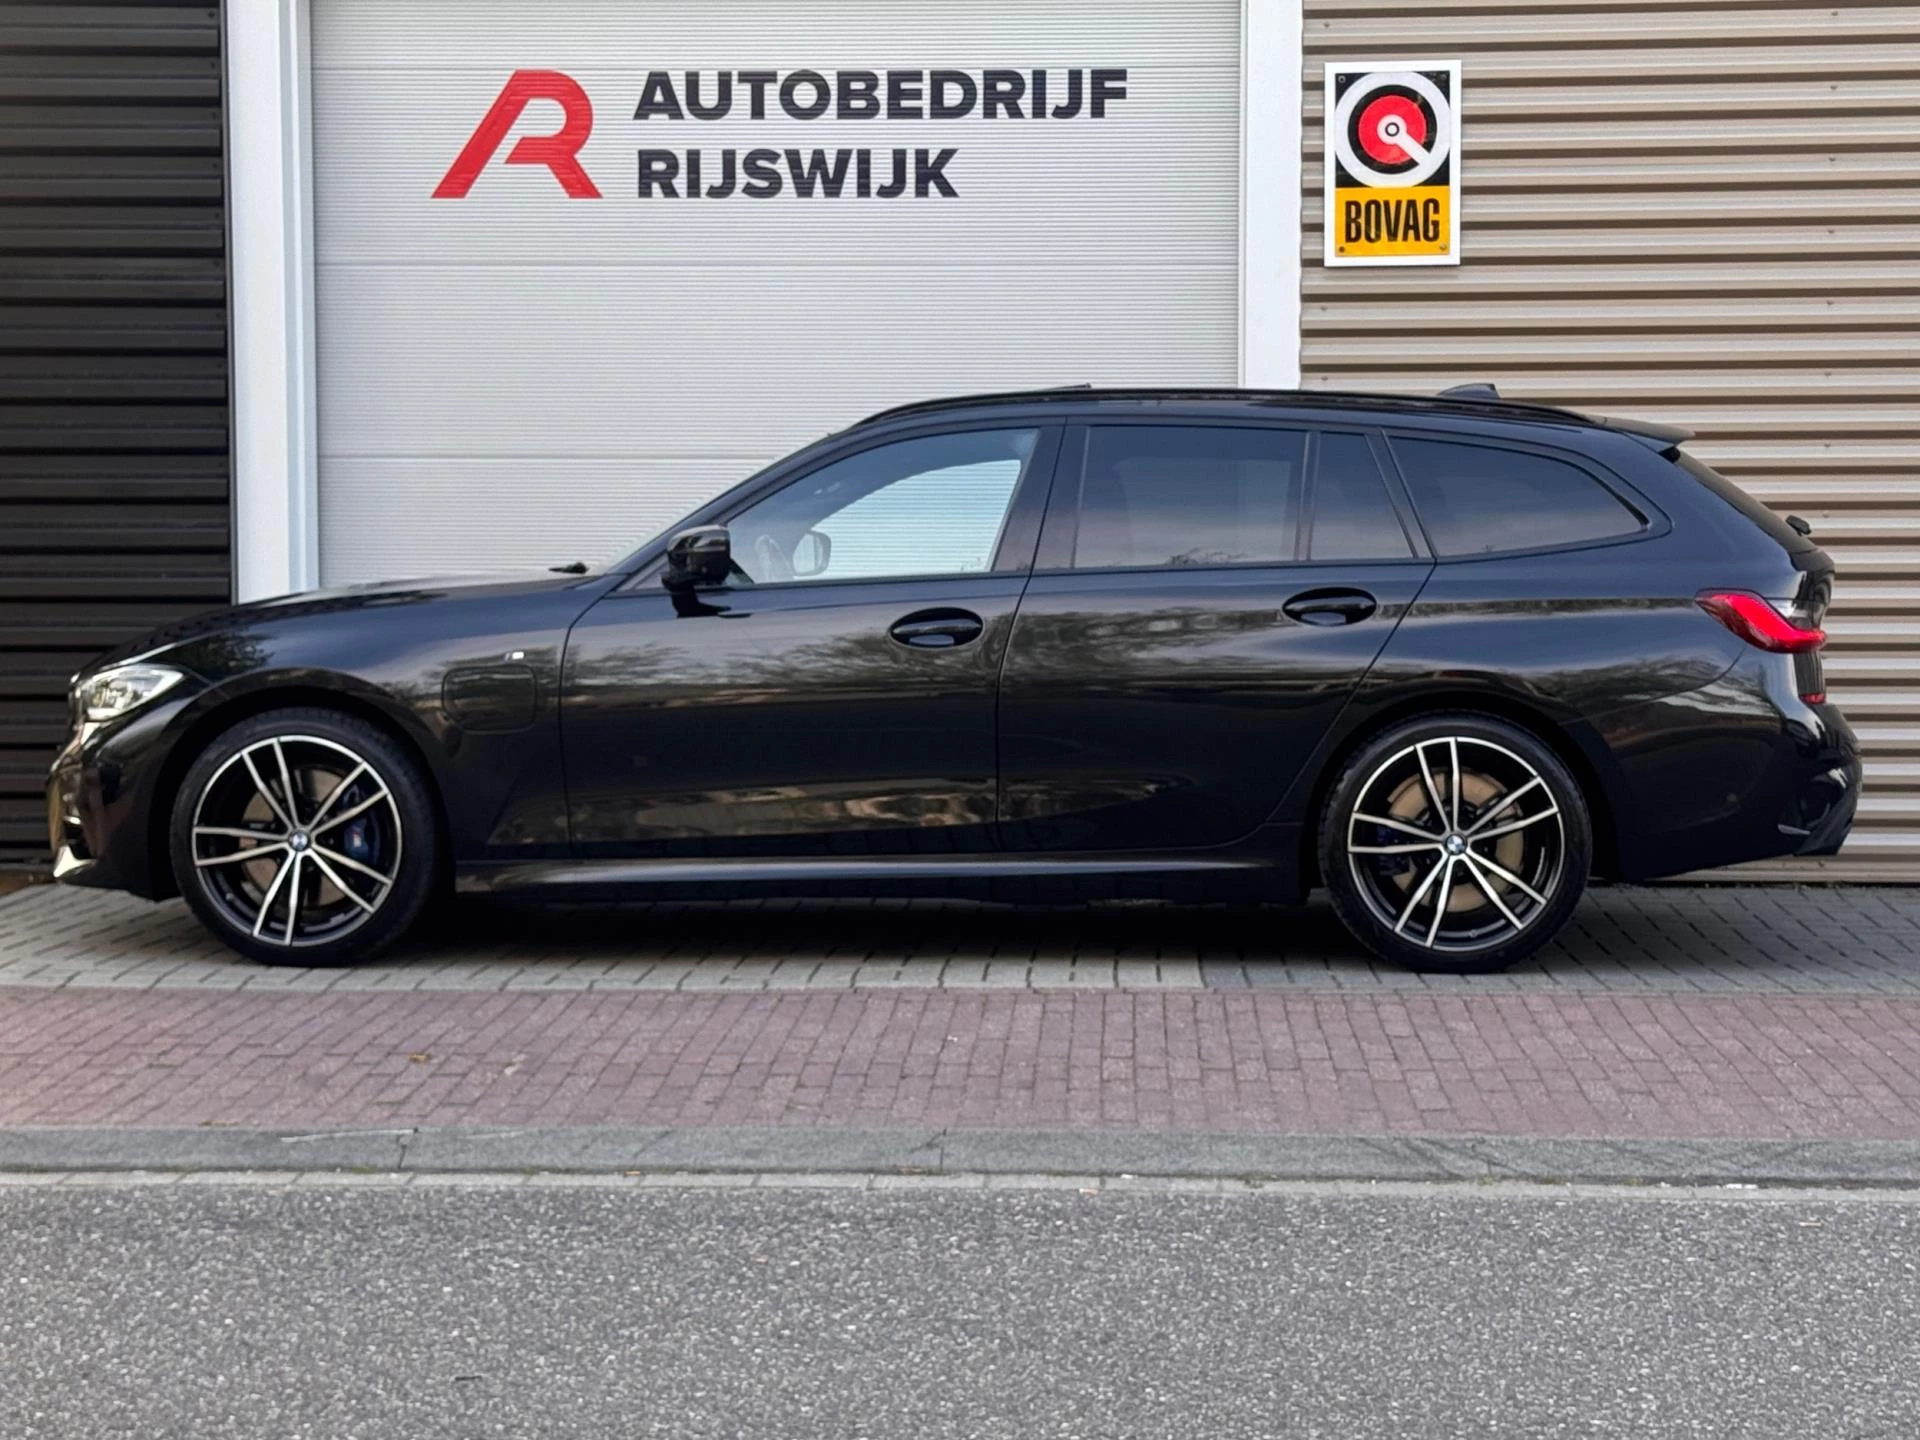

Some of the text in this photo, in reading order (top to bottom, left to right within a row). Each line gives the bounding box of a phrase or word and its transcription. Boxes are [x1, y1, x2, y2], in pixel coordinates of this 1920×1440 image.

[633, 68, 1127, 121] AUTOBEDRIJF
[637, 148, 959, 199] RIJSWIJK
[1344, 198, 1440, 244] BOVAG
